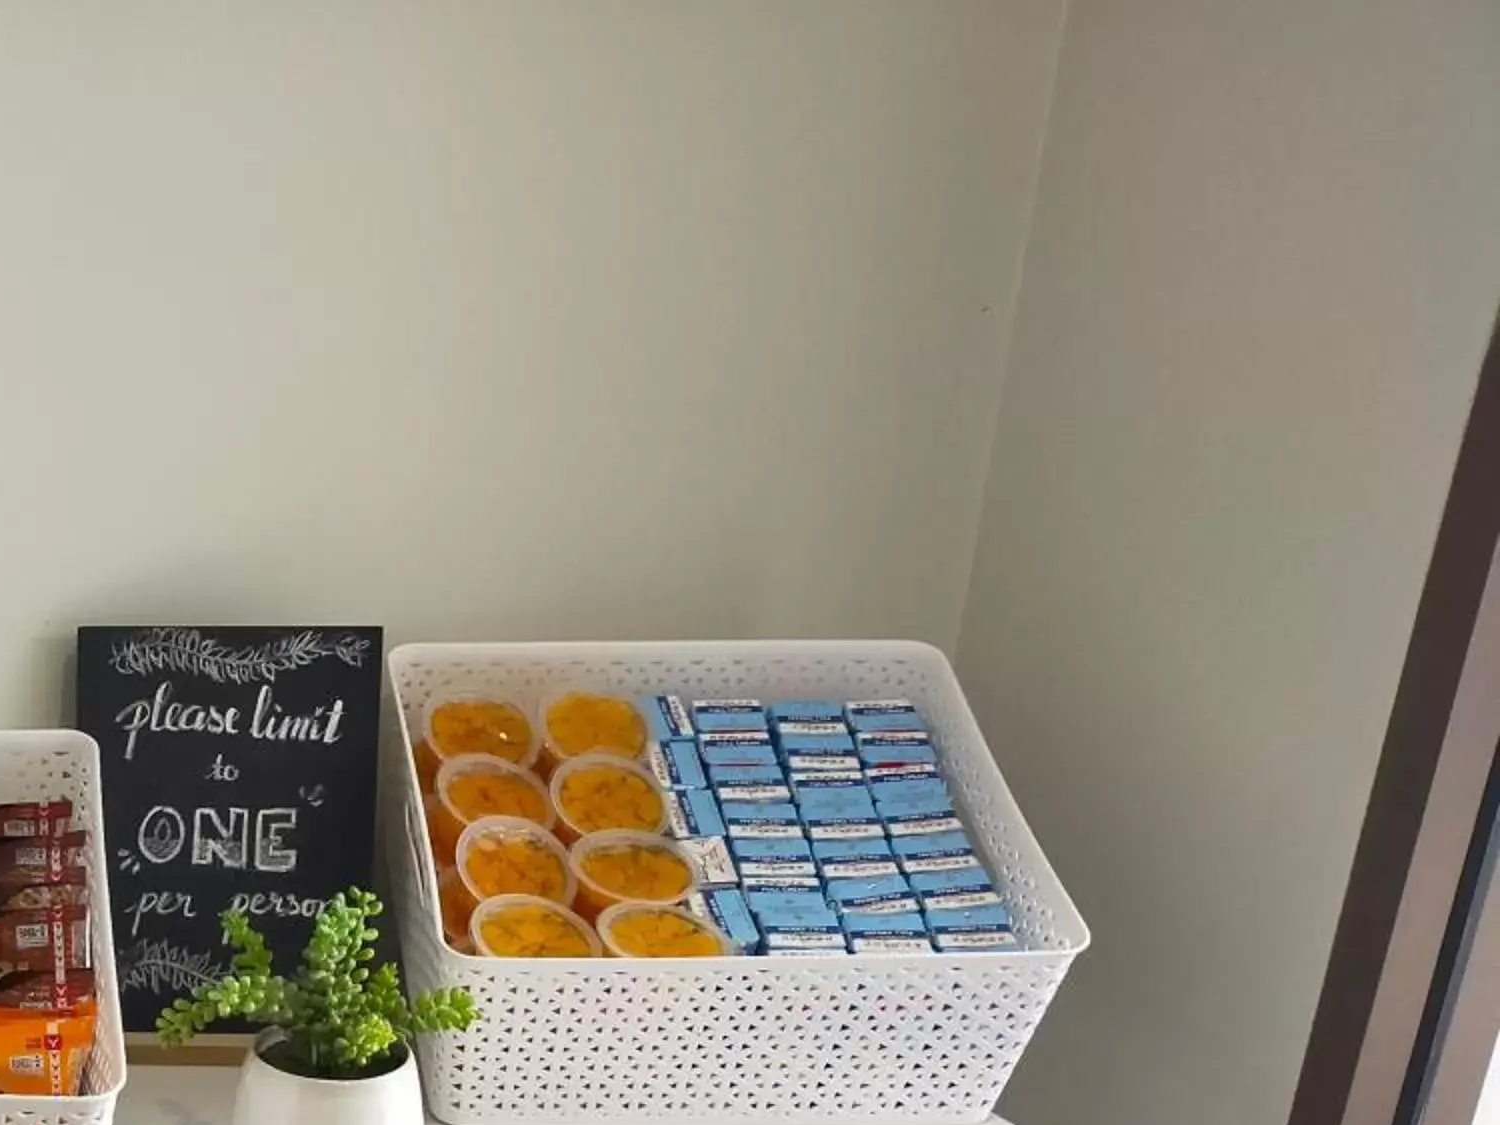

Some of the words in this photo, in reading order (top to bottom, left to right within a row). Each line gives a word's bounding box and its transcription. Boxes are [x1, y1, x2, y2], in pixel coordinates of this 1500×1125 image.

[116, 681, 240, 760] please
[250, 684, 345, 743] limit
[204, 753, 239, 782] to
[137, 805, 298, 873] ONE
[124, 891, 196, 937] per
